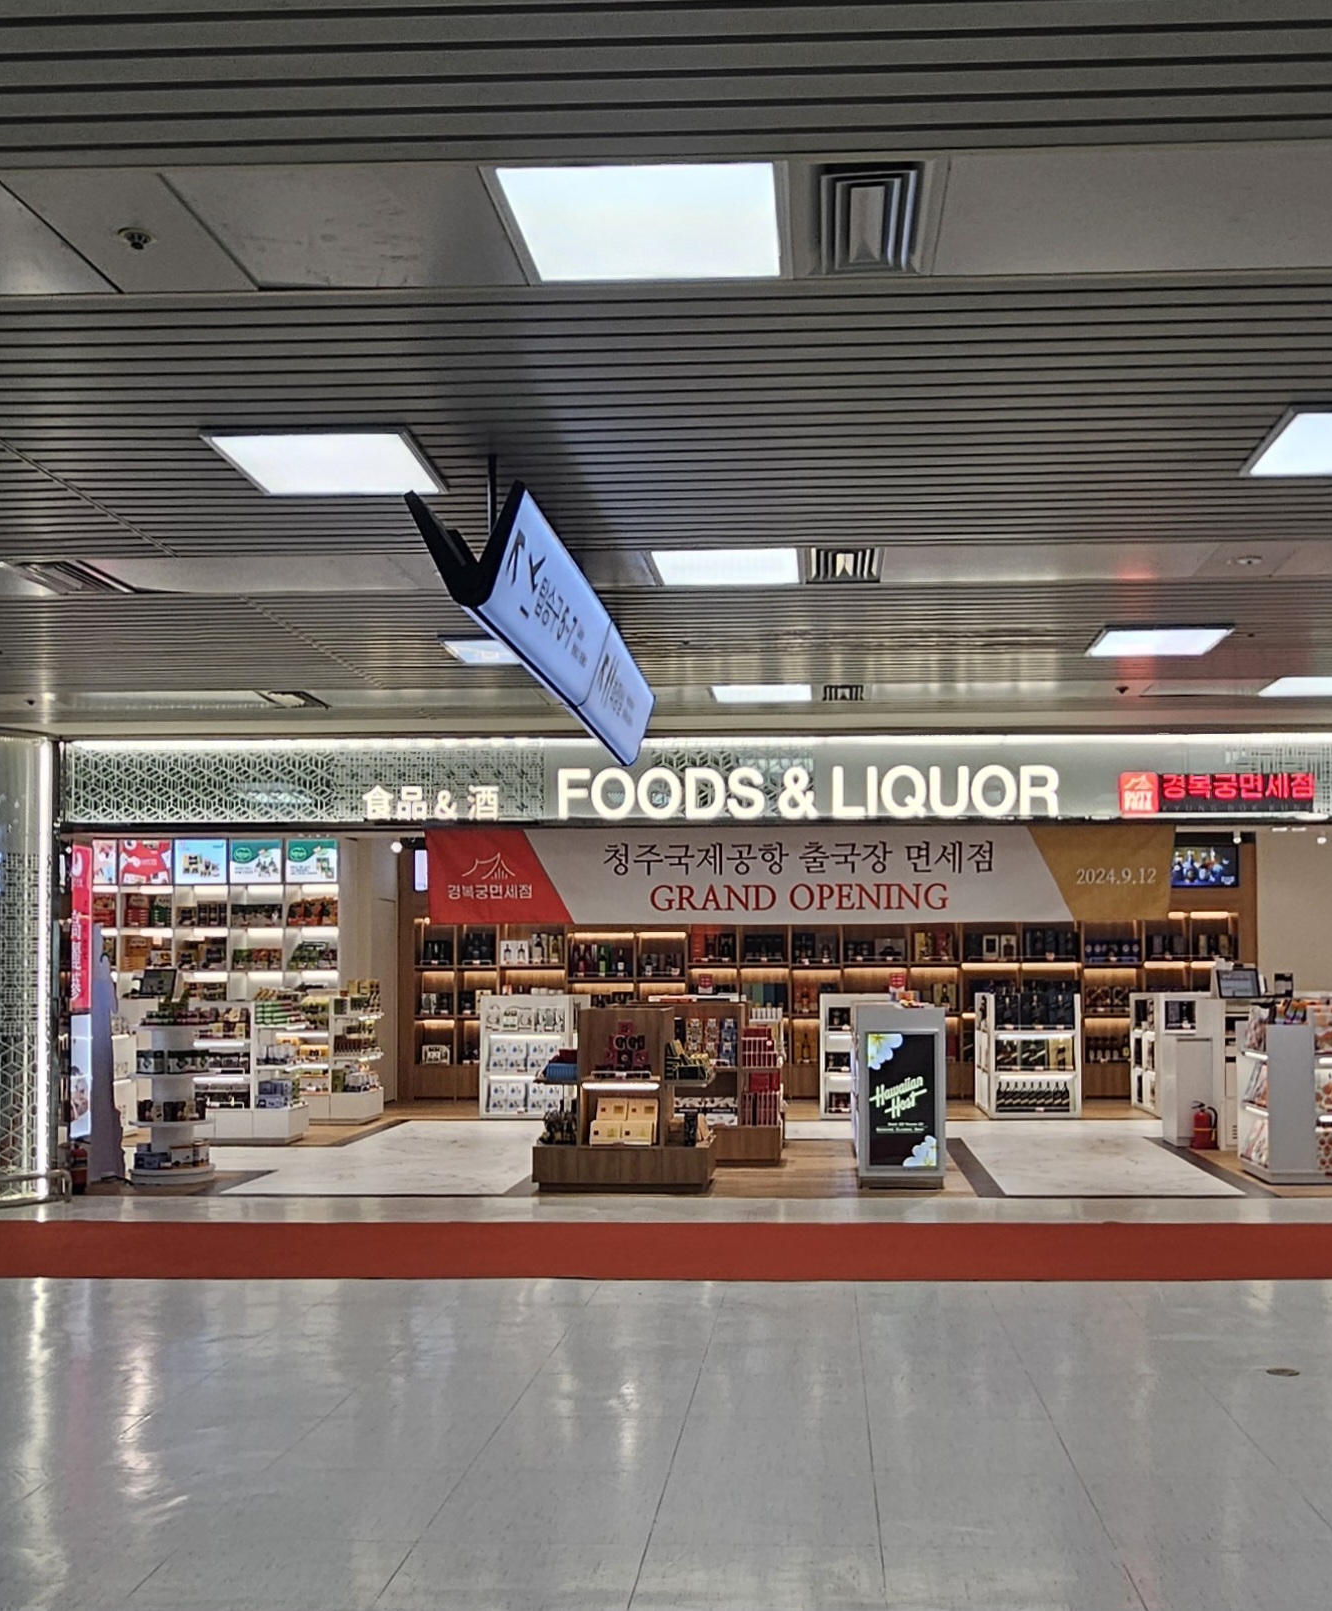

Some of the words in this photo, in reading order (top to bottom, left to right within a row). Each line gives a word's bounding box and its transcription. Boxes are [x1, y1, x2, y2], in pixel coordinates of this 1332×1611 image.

[557, 766, 765, 821] FOODS
[777, 766, 818, 820] &
[832, 764, 1059, 819] LIQUOR
[1162, 773, 1315, 799] 경복궁면세점
[362, 784, 428, 821] 食品
[435, 789, 459, 821] &
[467, 785, 500, 821] 酒
[603, 841, 789, 876] 청주국제공항
[798, 840, 893, 874] 출국장
[905, 839, 995, 874] 면세점
[1075, 867, 1157, 885] 2024.9.12
[447, 883, 533, 900] 경복궁면세점
[650, 884, 777, 912] GRAND
[788, 882, 950, 911] OPENING
[869, 1075, 924, 1108] Hawaiian
[884, 1089, 928, 1119] Host
